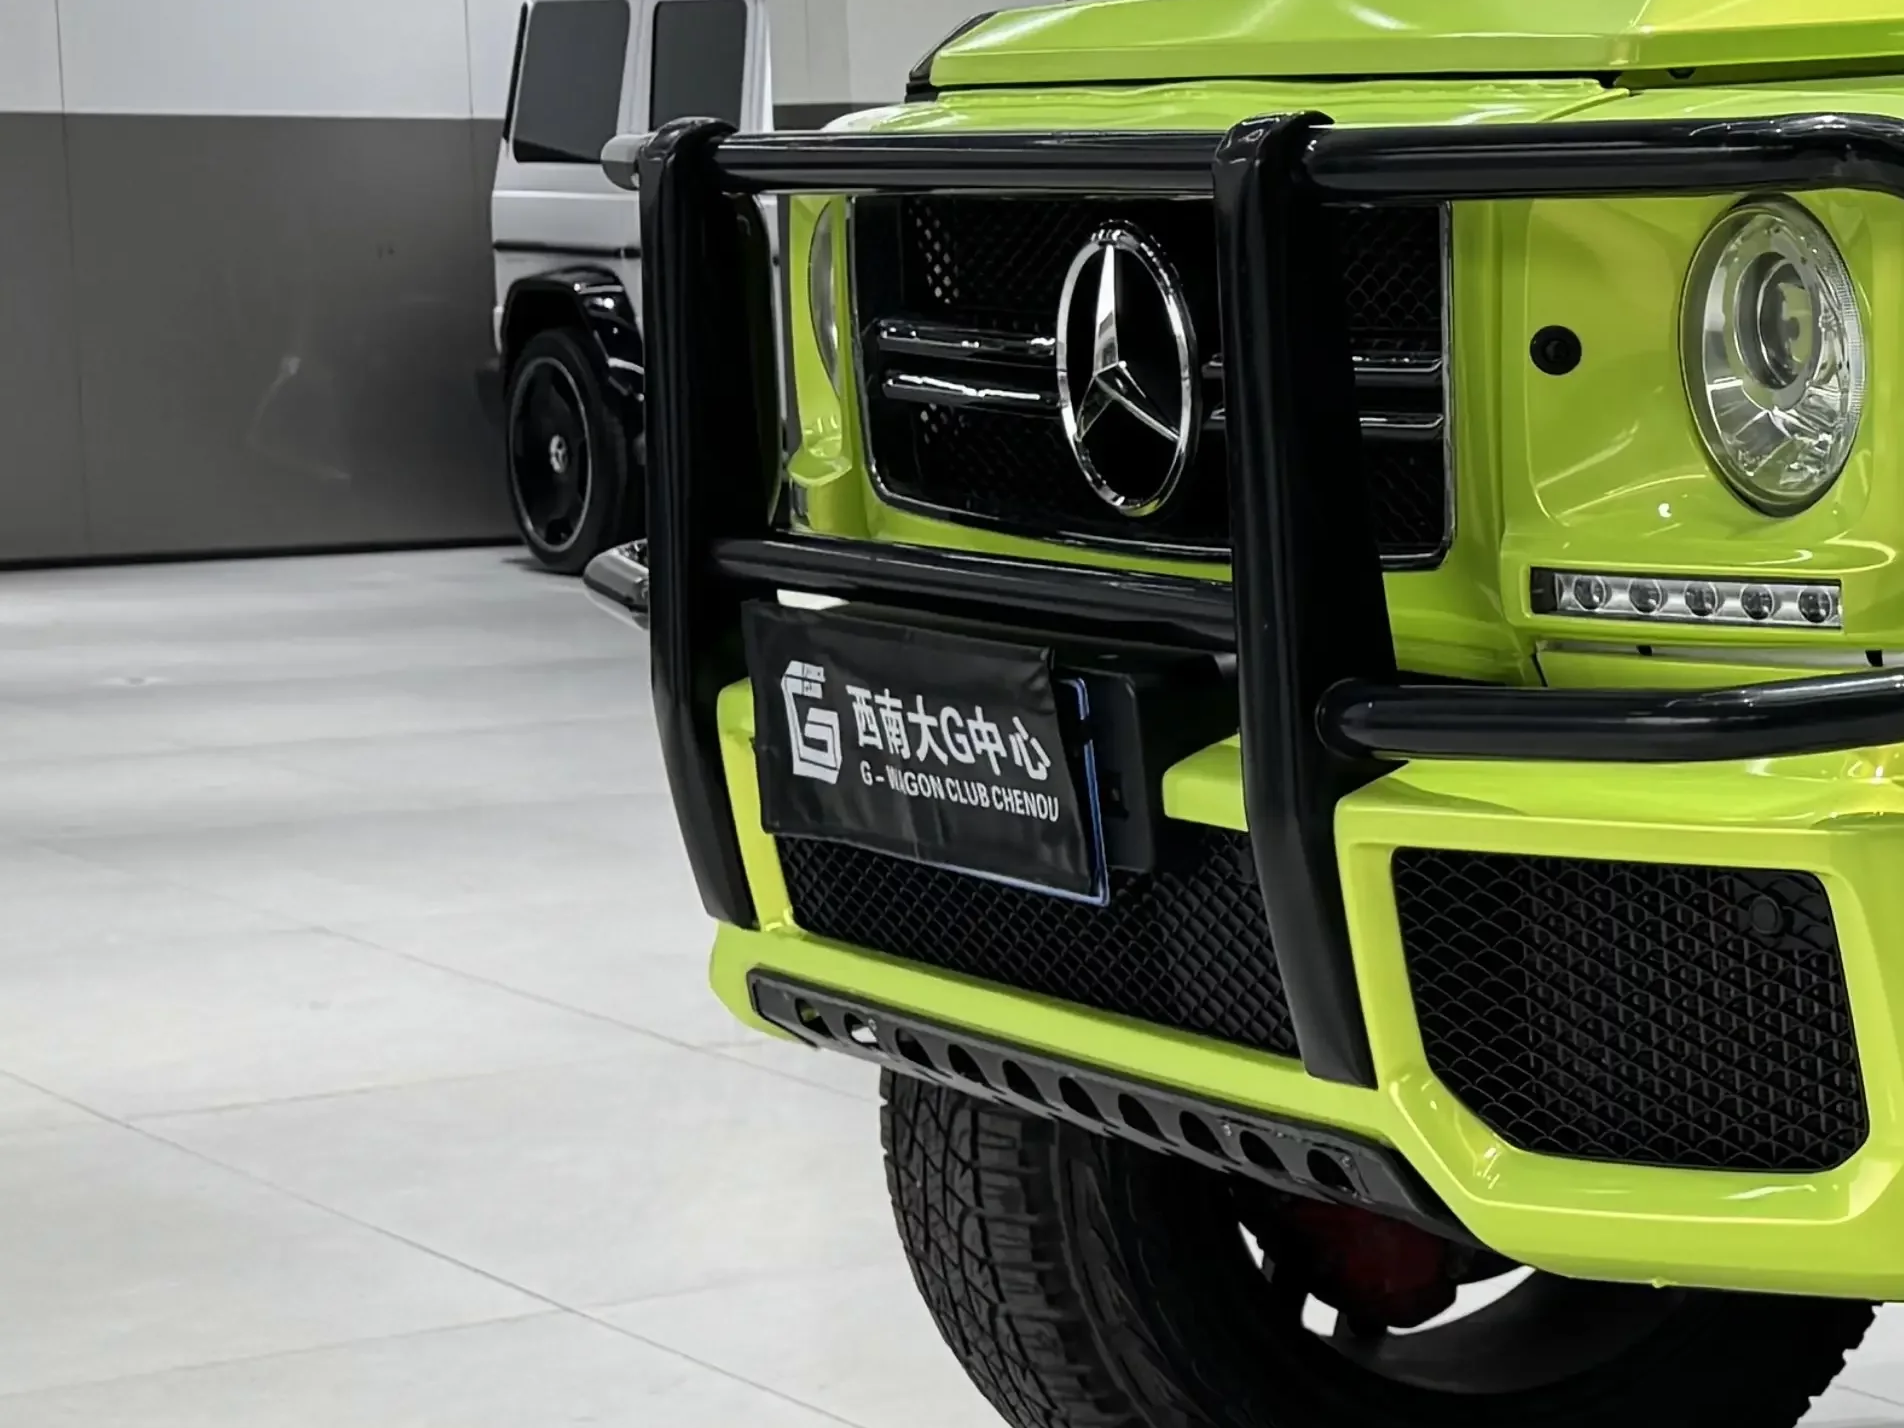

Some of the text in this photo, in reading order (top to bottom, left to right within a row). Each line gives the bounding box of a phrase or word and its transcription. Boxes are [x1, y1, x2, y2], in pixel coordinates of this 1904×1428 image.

[845, 684, 1051, 781] 西南大G中心
[944, 777, 990, 808] CLUB
